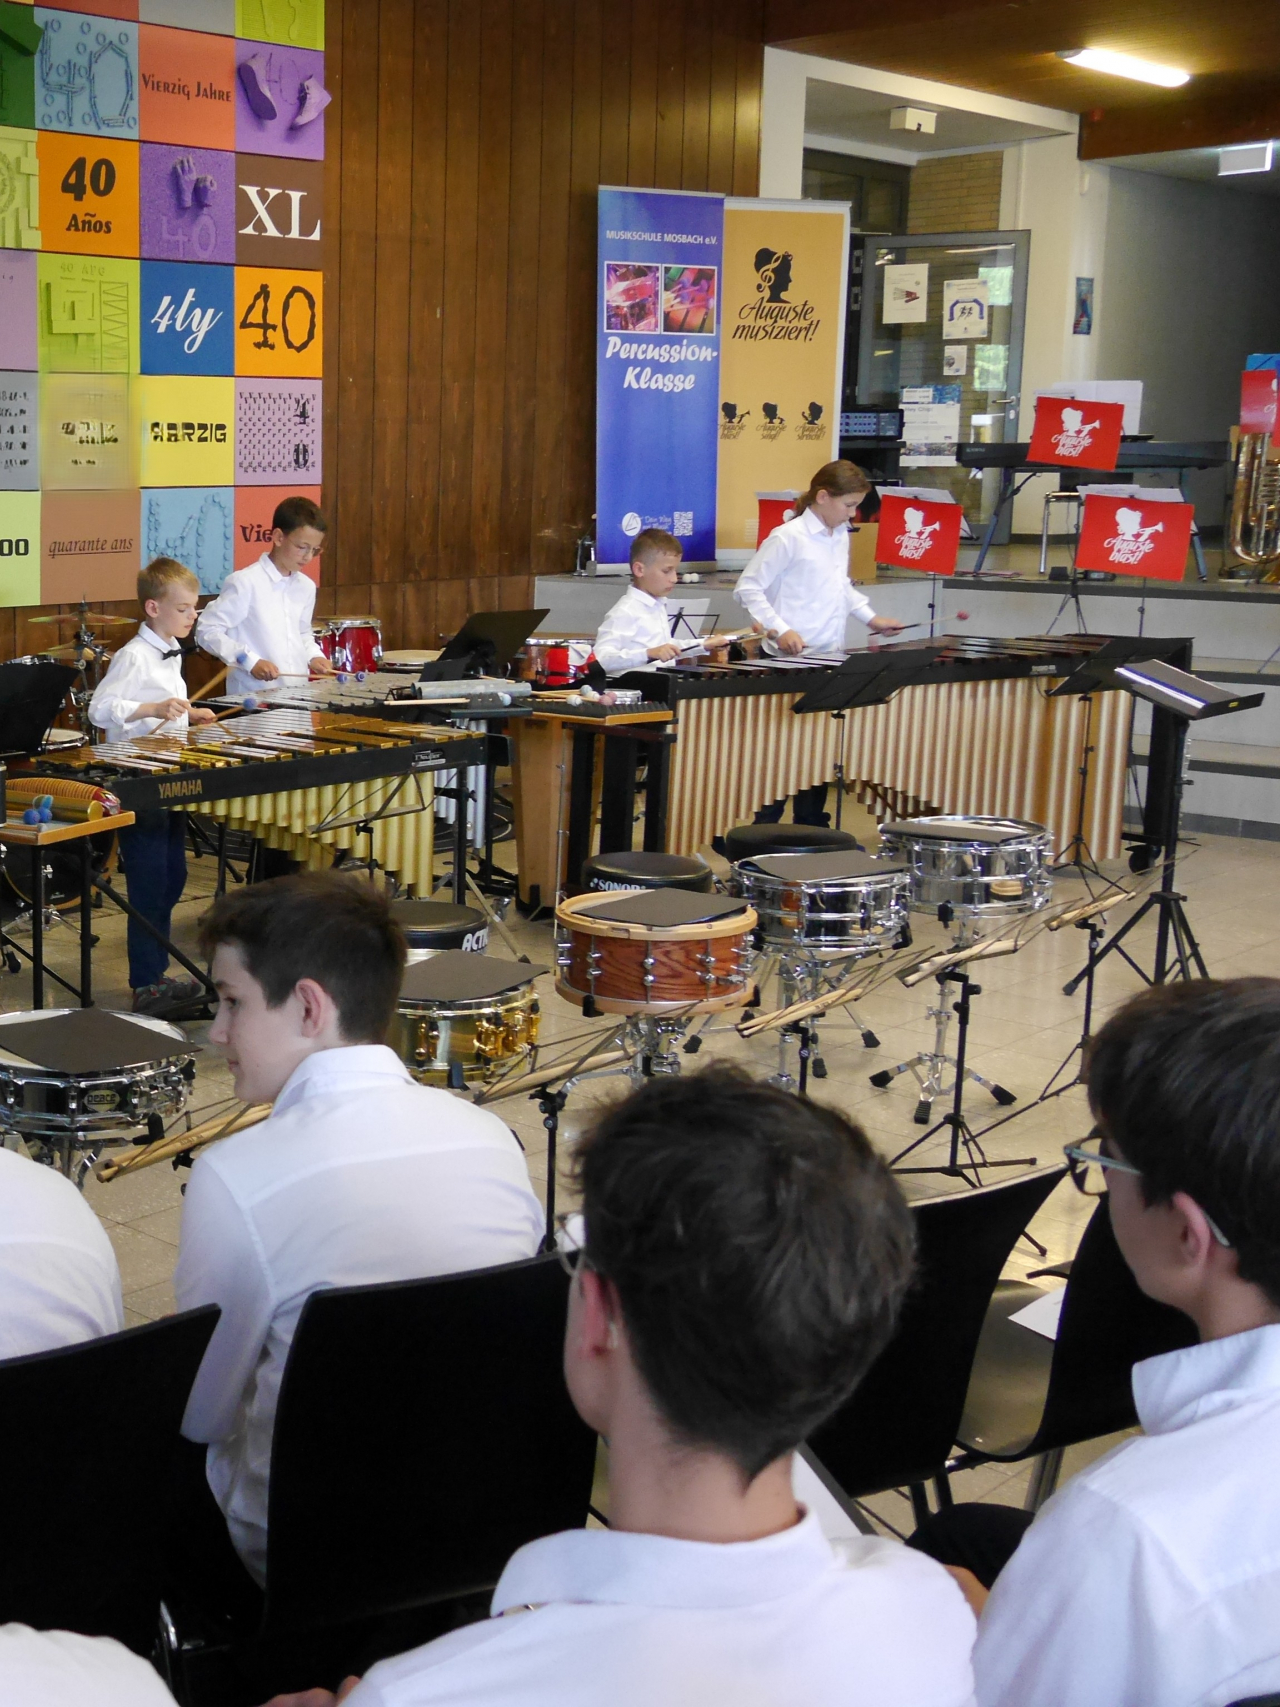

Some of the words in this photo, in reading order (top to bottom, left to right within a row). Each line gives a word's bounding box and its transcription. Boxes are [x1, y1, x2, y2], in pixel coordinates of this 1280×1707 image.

[61, 156, 116, 202] 40
[66, 212, 112, 235] Años
[238, 184, 320, 241] XL
[606, 230, 662, 243] MUSIKSCHULE
[664, 233, 703, 244] MOSBACH
[150, 288, 223, 354] 4ty
[239, 283, 317, 354] 40
[738, 296, 815, 324] Auguste
[732, 319, 820, 342] musiziert!
[605, 336, 718, 363] Percussion-
[623, 366, 696, 393] Klasse
[240, 524, 273, 543] Vie
[49, 539, 107, 558] quarante
[111, 537, 133, 550] ans
[158, 779, 203, 798] YAMAHA
